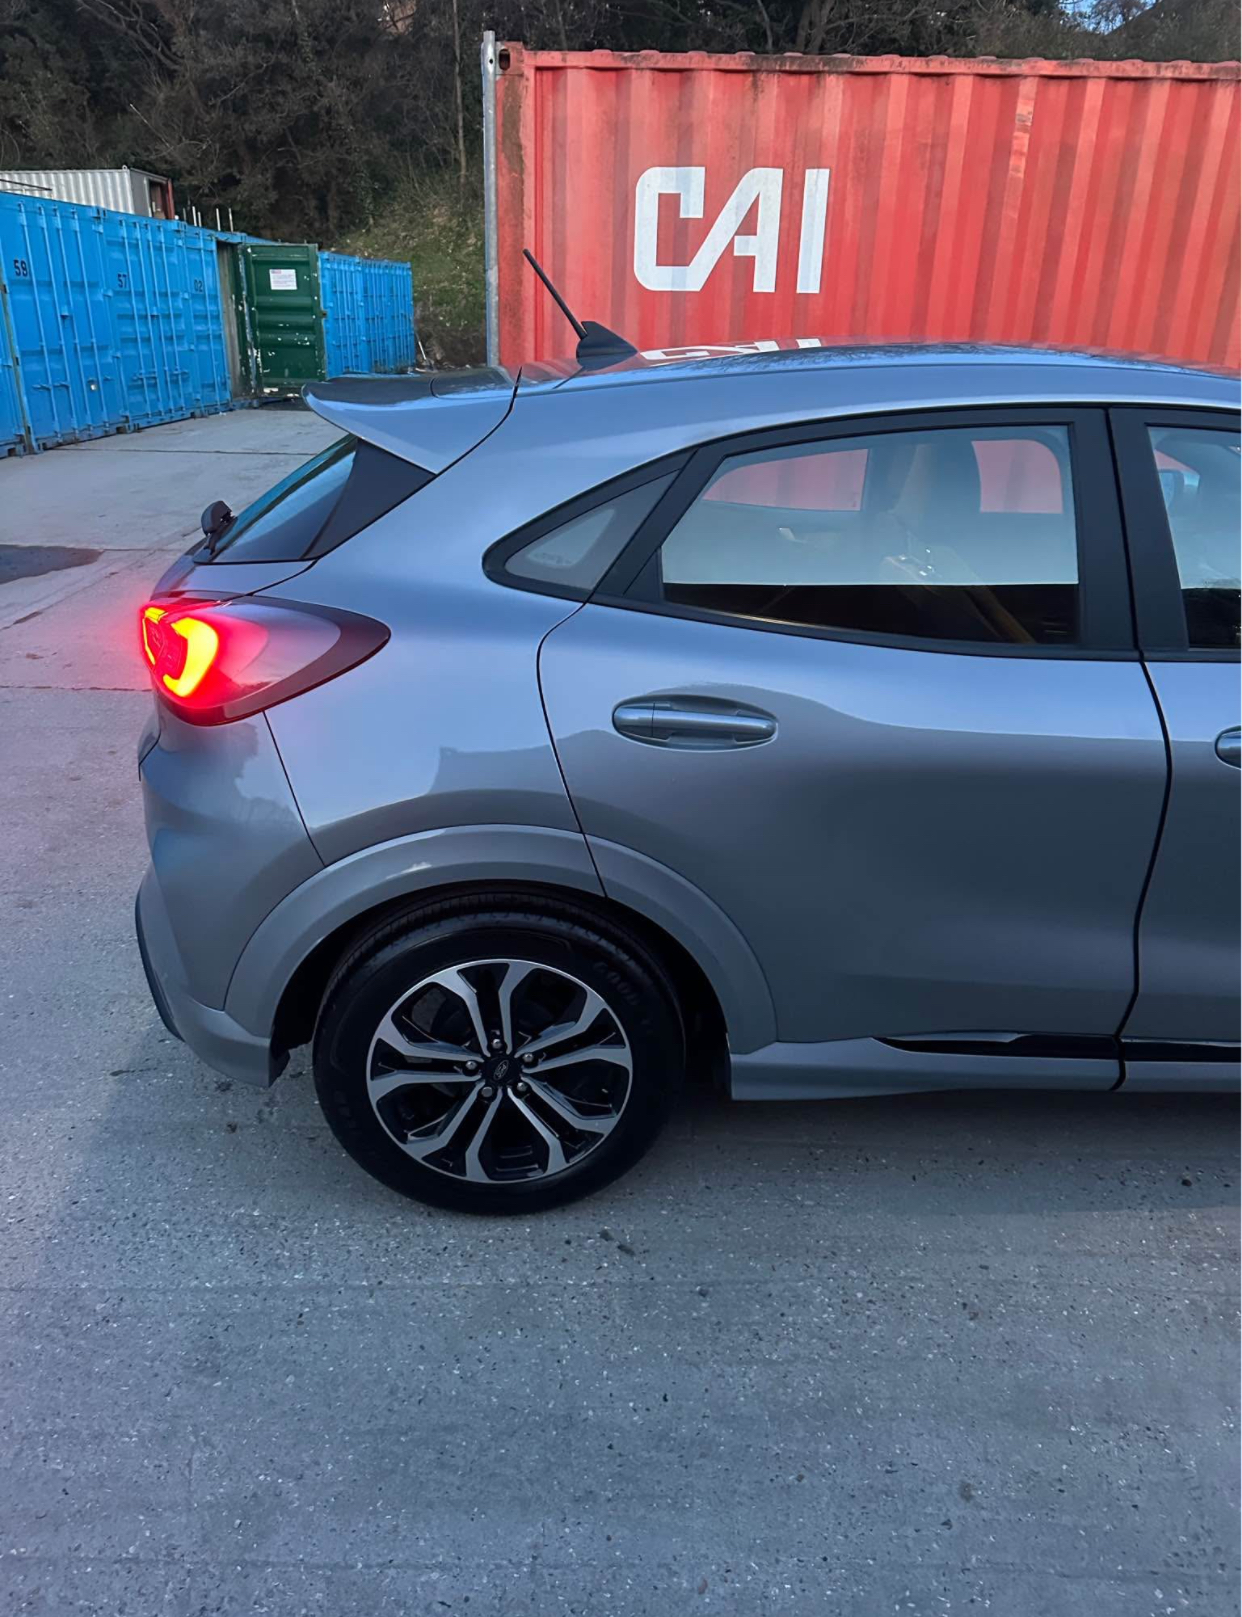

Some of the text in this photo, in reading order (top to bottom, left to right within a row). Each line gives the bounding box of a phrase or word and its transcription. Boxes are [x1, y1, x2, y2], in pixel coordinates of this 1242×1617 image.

[634, 166, 830, 294] CAI
[13, 258, 28, 277] 59
[117, 273, 128, 288] 57
